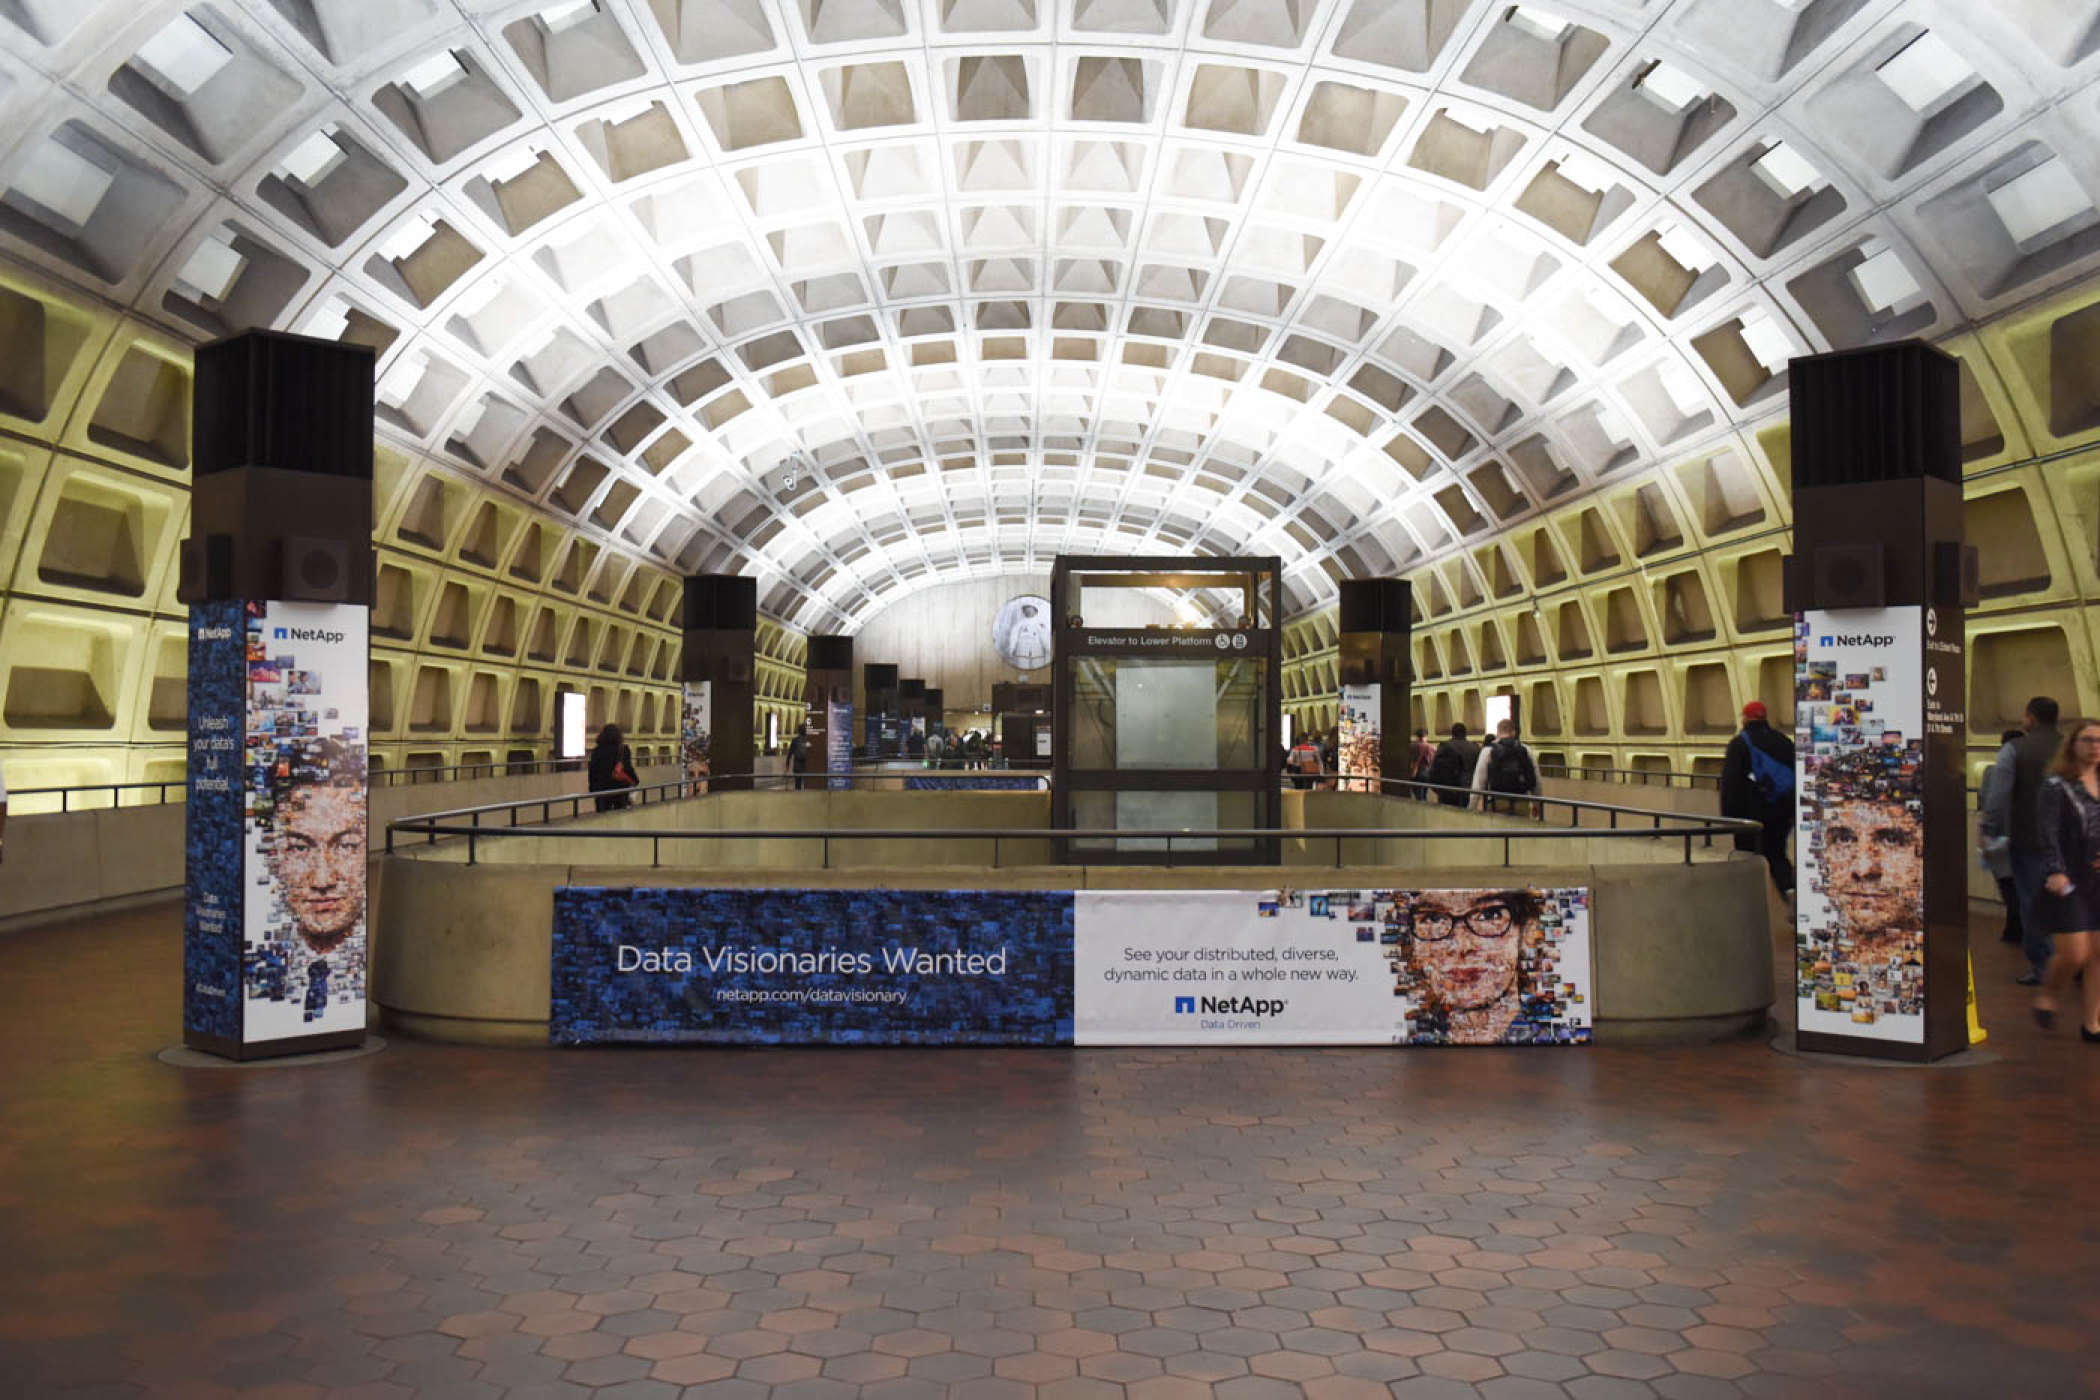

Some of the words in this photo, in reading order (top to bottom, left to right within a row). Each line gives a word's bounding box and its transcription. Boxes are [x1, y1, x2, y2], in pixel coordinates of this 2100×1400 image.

[291, 628, 344, 644] NetApp
[1088, 636, 1126, 646] Elevator
[1128, 636, 1138, 646] to
[1141, 636, 1169, 646] Lower
[1172, 636, 1212, 646] Platform
[1837, 634, 1894, 648] NetApp
[198, 714, 229, 730] Unleash
[618, 945, 691, 972] Data
[702, 946, 872, 973] Visionaries
[882, 947, 1006, 975] Wanted
[1124, 948, 1152, 961] See
[1156, 950, 1190, 963] your
[1194, 948, 1278, 962] distributed,
[1282, 947, 1338, 961] diverse,
[1104, 968, 1169, 983] dynamic
[1173, 968, 1207, 981] data
[1211, 968, 1224, 981] in
[1228, 970, 1237, 981] a
[1242, 967, 1286, 981] whole
[1290, 970, 1321, 981] new
[1326, 970, 1359, 982] way.
[716, 986, 907, 1004] netapp.com/datavisionary
[1201, 996, 1285, 1017] NetApp
[1201, 1020, 1225, 1029] Data
[1228, 1020, 1261, 1029] Driven
